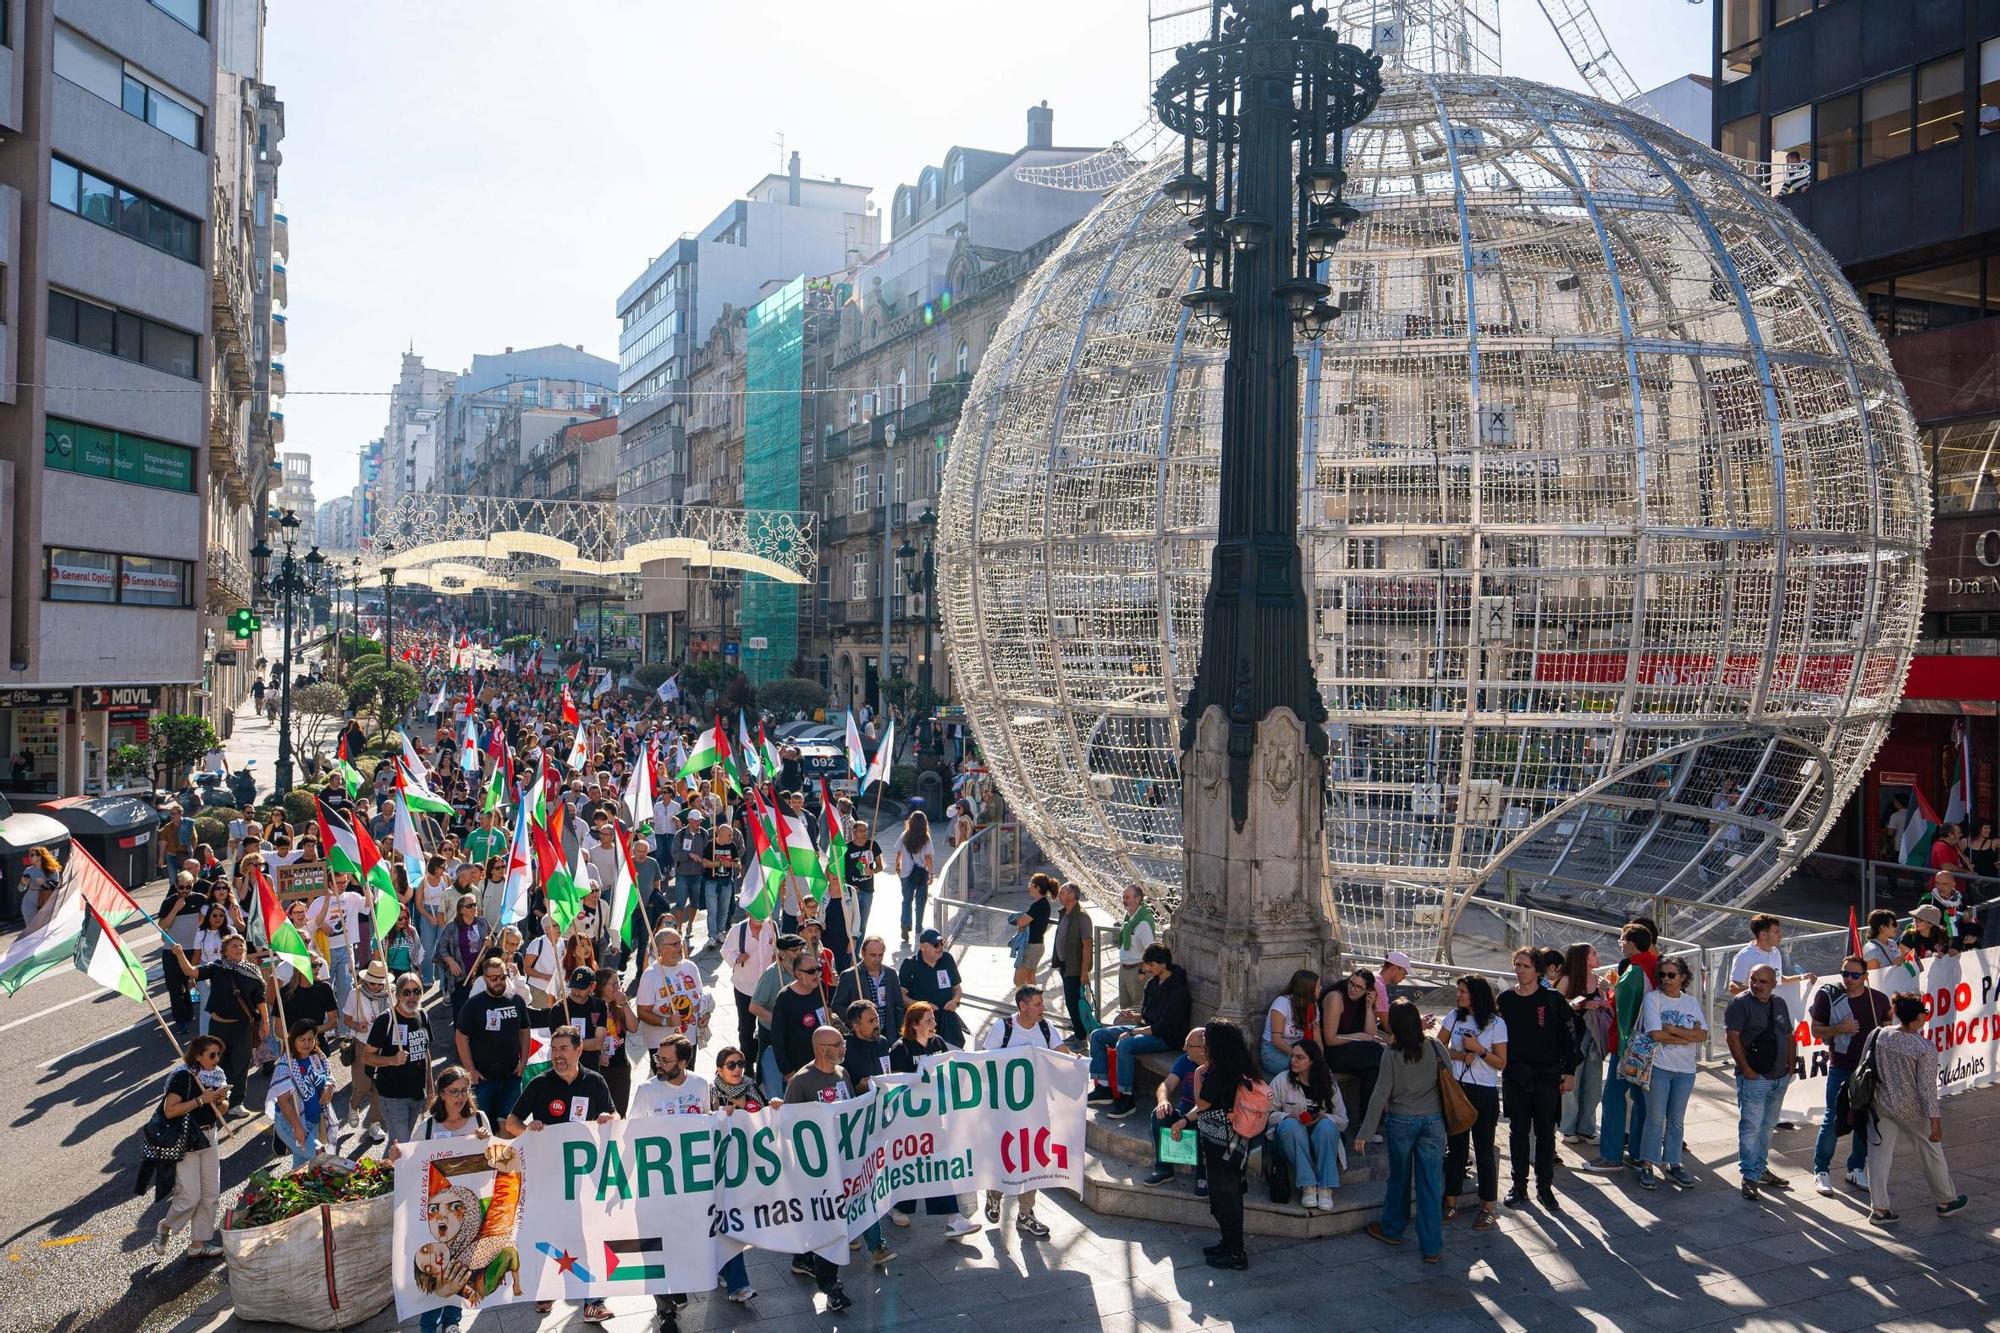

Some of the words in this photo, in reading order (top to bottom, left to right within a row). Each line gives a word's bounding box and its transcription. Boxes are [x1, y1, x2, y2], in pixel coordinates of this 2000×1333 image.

[62, 570, 90, 582] General
[132, 575, 157, 587] General
[1948, 578, 1985, 594] Dra.
[111, 688, 152, 705] MOVIL
[812, 757, 836, 767] 092
[576, 973, 583, 981] P
[1921, 982, 1972, 1022] ODO
[499, 1009, 518, 1020] ANS
[409, 1044, 426, 1055] RIAL
[410, 1052, 427, 1062] ISTA
[1792, 1050, 1830, 1080] AR
[1937, 1056, 1985, 1087] studantes
[792, 1120, 828, 1178] O
[892, 1132, 935, 1161] coa
[754, 1197, 804, 1229] nas
[810, 1189, 848, 1222] rúa
